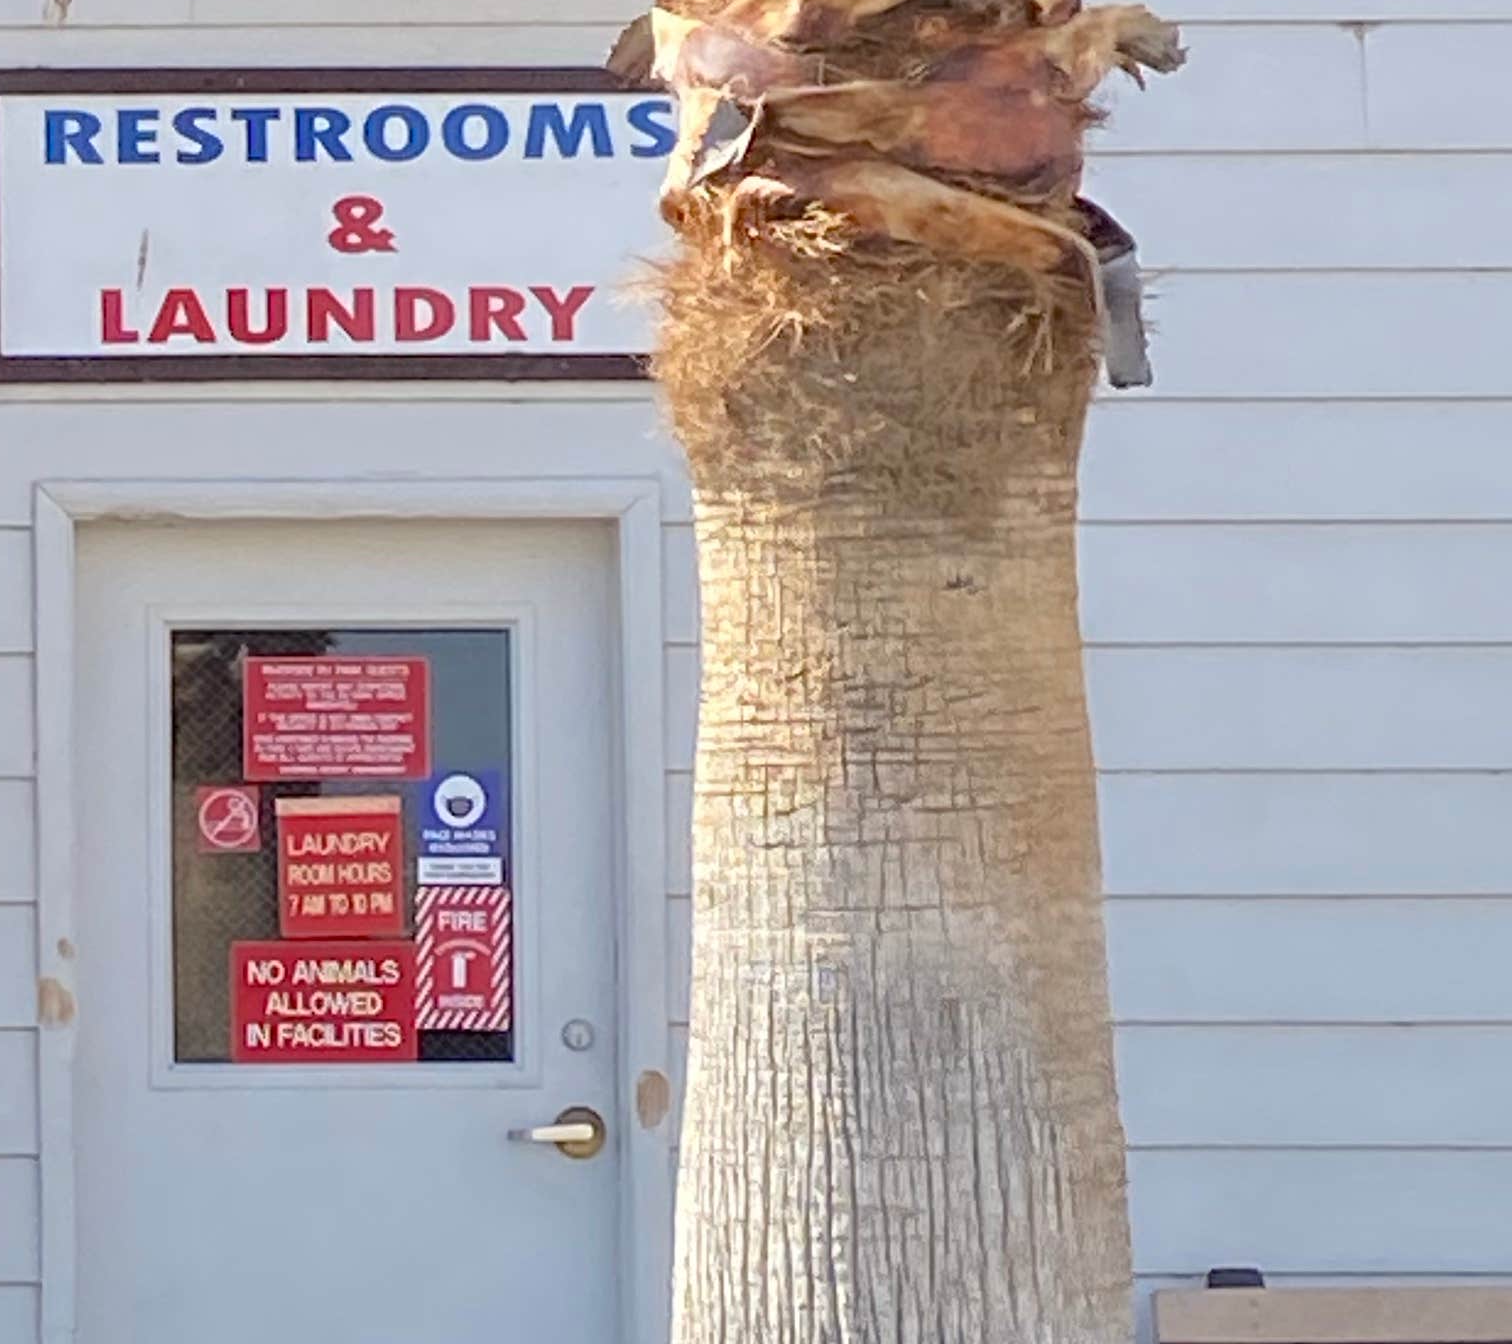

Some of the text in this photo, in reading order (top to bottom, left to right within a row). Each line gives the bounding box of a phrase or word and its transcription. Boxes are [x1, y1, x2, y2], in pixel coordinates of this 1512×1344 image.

[43, 100, 676, 165] RESTROOMS
[328, 195, 398, 254] &
[101, 286, 595, 345] LAUNDRY
[287, 832, 391, 856] LAUNDRY
[288, 861, 393, 886] ROOM HOURS
[288, 892, 394, 916] 7 AM TO 10 PM
[438, 909, 488, 932] FIRE
[247, 959, 401, 986] NO ANIMALS
[265, 991, 384, 1016] ALLOWED
[246, 1021, 403, 1048] IN FACILITIES
